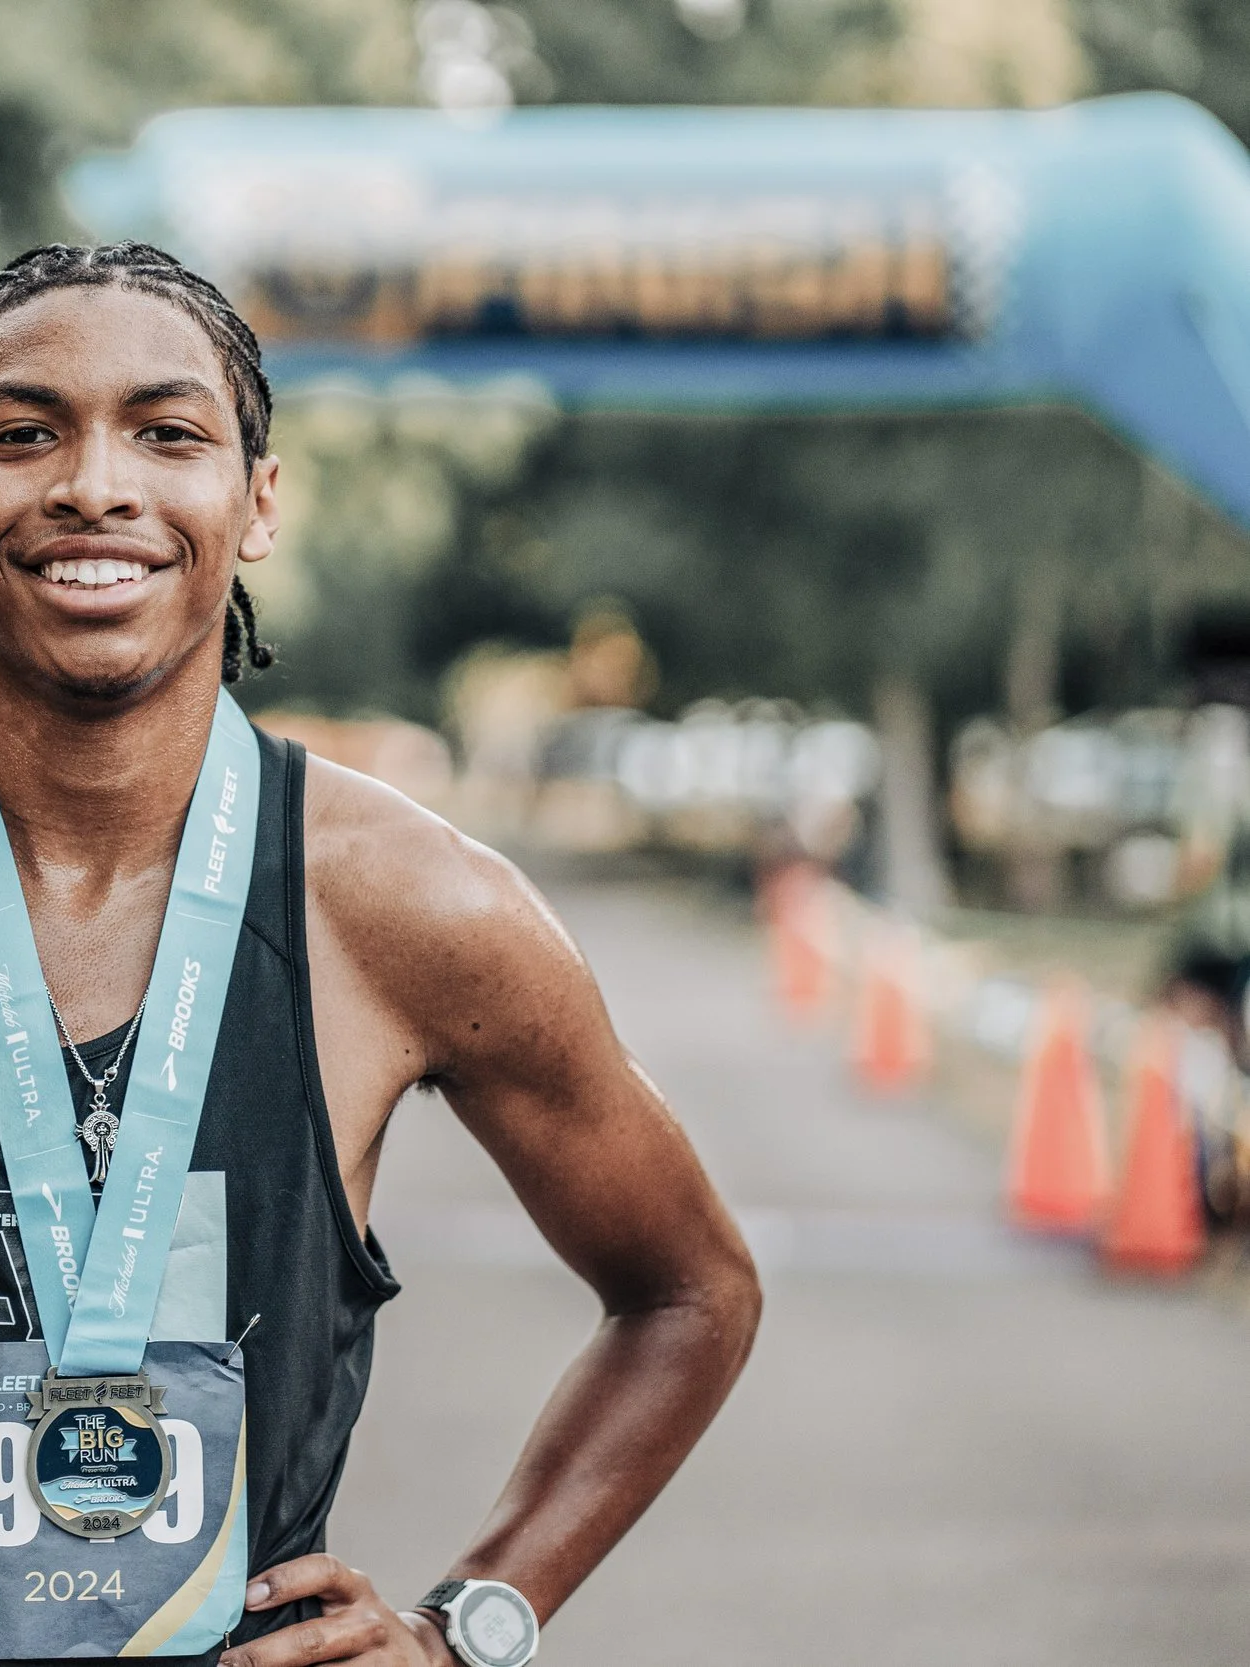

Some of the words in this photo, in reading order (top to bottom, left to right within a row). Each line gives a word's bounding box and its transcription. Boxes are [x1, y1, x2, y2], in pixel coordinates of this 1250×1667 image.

[204, 836, 227, 894] FLEET
[168, 956, 201, 1052] BROOKS
[50, 1225, 81, 1315] BROOK
[108, 1241, 138, 1319] Michelob
[50, 1386, 92, 1401] FLEET
[110, 1384, 145, 1399] FEET
[74, 1415, 107, 1431] THE
[79, 1427, 125, 1450] BIG
[80, 1448, 117, 1463] RUN
[90, 1494, 127, 1504] BROOKS
[83, 1516, 122, 1531] 2024
[24, 1569, 125, 1603] 2024
